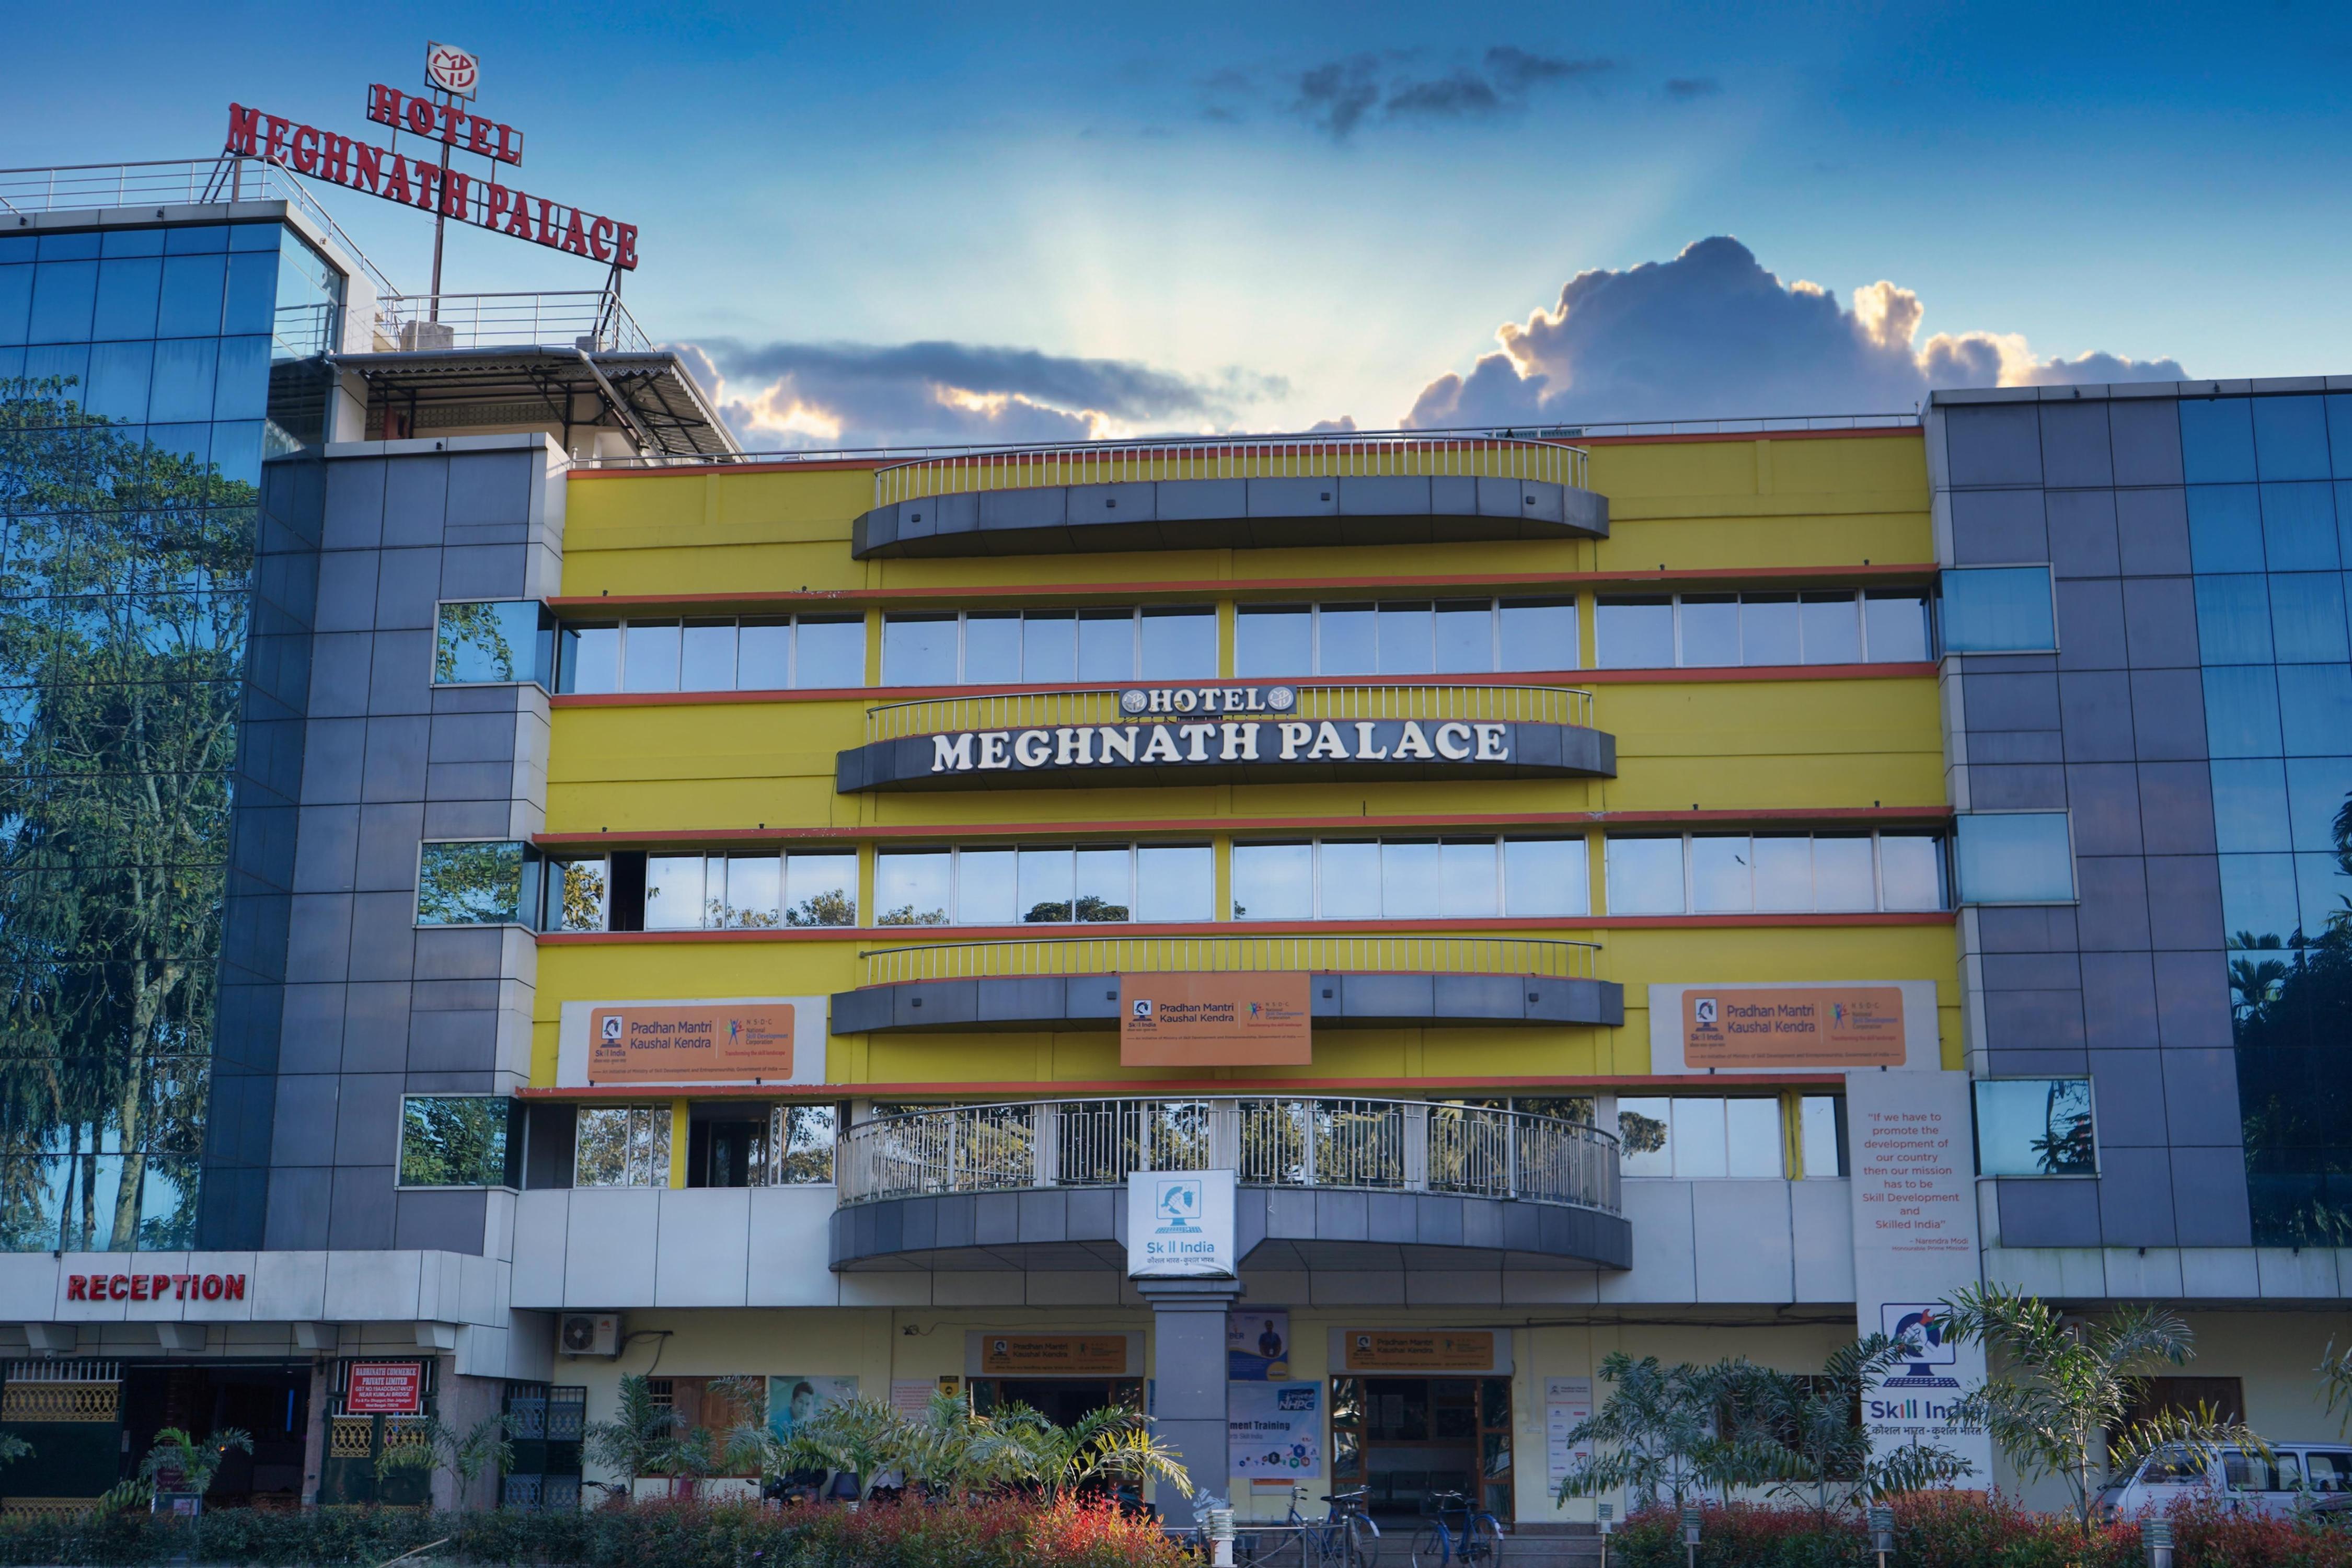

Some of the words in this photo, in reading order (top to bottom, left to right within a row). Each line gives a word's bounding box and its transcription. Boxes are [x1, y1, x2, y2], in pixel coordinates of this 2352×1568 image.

[371, 83, 520, 165] HOTEL
[226, 102, 471, 220] MEGHNATH
[486, 182, 639, 270] PALACE
[1148, 688, 1266, 712] HOTEL
[931, 721, 1261, 773] MEGHNATH
[1278, 721, 1509, 763] PALACE
[1160, 1003, 1201, 1012] Pradhan
[1203, 1002, 1234, 1012] Mantri
[1727, 1005, 1774, 1017] Pradhan
[1778, 1004, 1814, 1017] Mantri
[1160, 1014, 1197, 1023] Kaushal
[631, 1021, 675, 1034] Pradhan
[678, 1020, 712, 1033] Mantri
[1727, 1021, 1771, 1033] Kaushal
[1775, 1021, 1815, 1033] Kendra
[630, 1037, 670, 1050] Kaushal
[674, 1036, 711, 1048] Kendra
[1903, 1113, 1927, 1122] have
[1873, 1127, 1918, 1137] promote
[1922, 1126, 1939, 1135] the
[1864, 1140, 1934, 1149] development
[1938, 1139, 1949, 1148] of
[1897, 1154, 1938, 1163] country
[1864, 1167, 1887, 1175] then
[1912, 1167, 1952, 1175] mission
[1884, 1180, 1901, 1189] has
[1920, 1180, 1933, 1188] be
[1863, 1193, 1884, 1202] Skill
[1888, 1194, 1959, 1203] Development
[1900, 1206, 1920, 1215] and
[1875, 1220, 1911, 1229] Skilled
[1180, 1241, 1215, 1253] India
[67, 1274, 246, 1301] RECEPTION
[387, 1367, 416, 1376] COMMERCE
[1279, 1401, 1314, 1410] NHPC
[1871, 1399, 1917, 1419] Skill
[1254, 1421, 1290, 1431] Training
[1872, 1424, 1900, 1435] कौशल
[1903, 1426, 1925, 1435] भारत
[1931, 1426, 1957, 1439] कुशल
[1959, 1426, 1981, 1435] भारत
